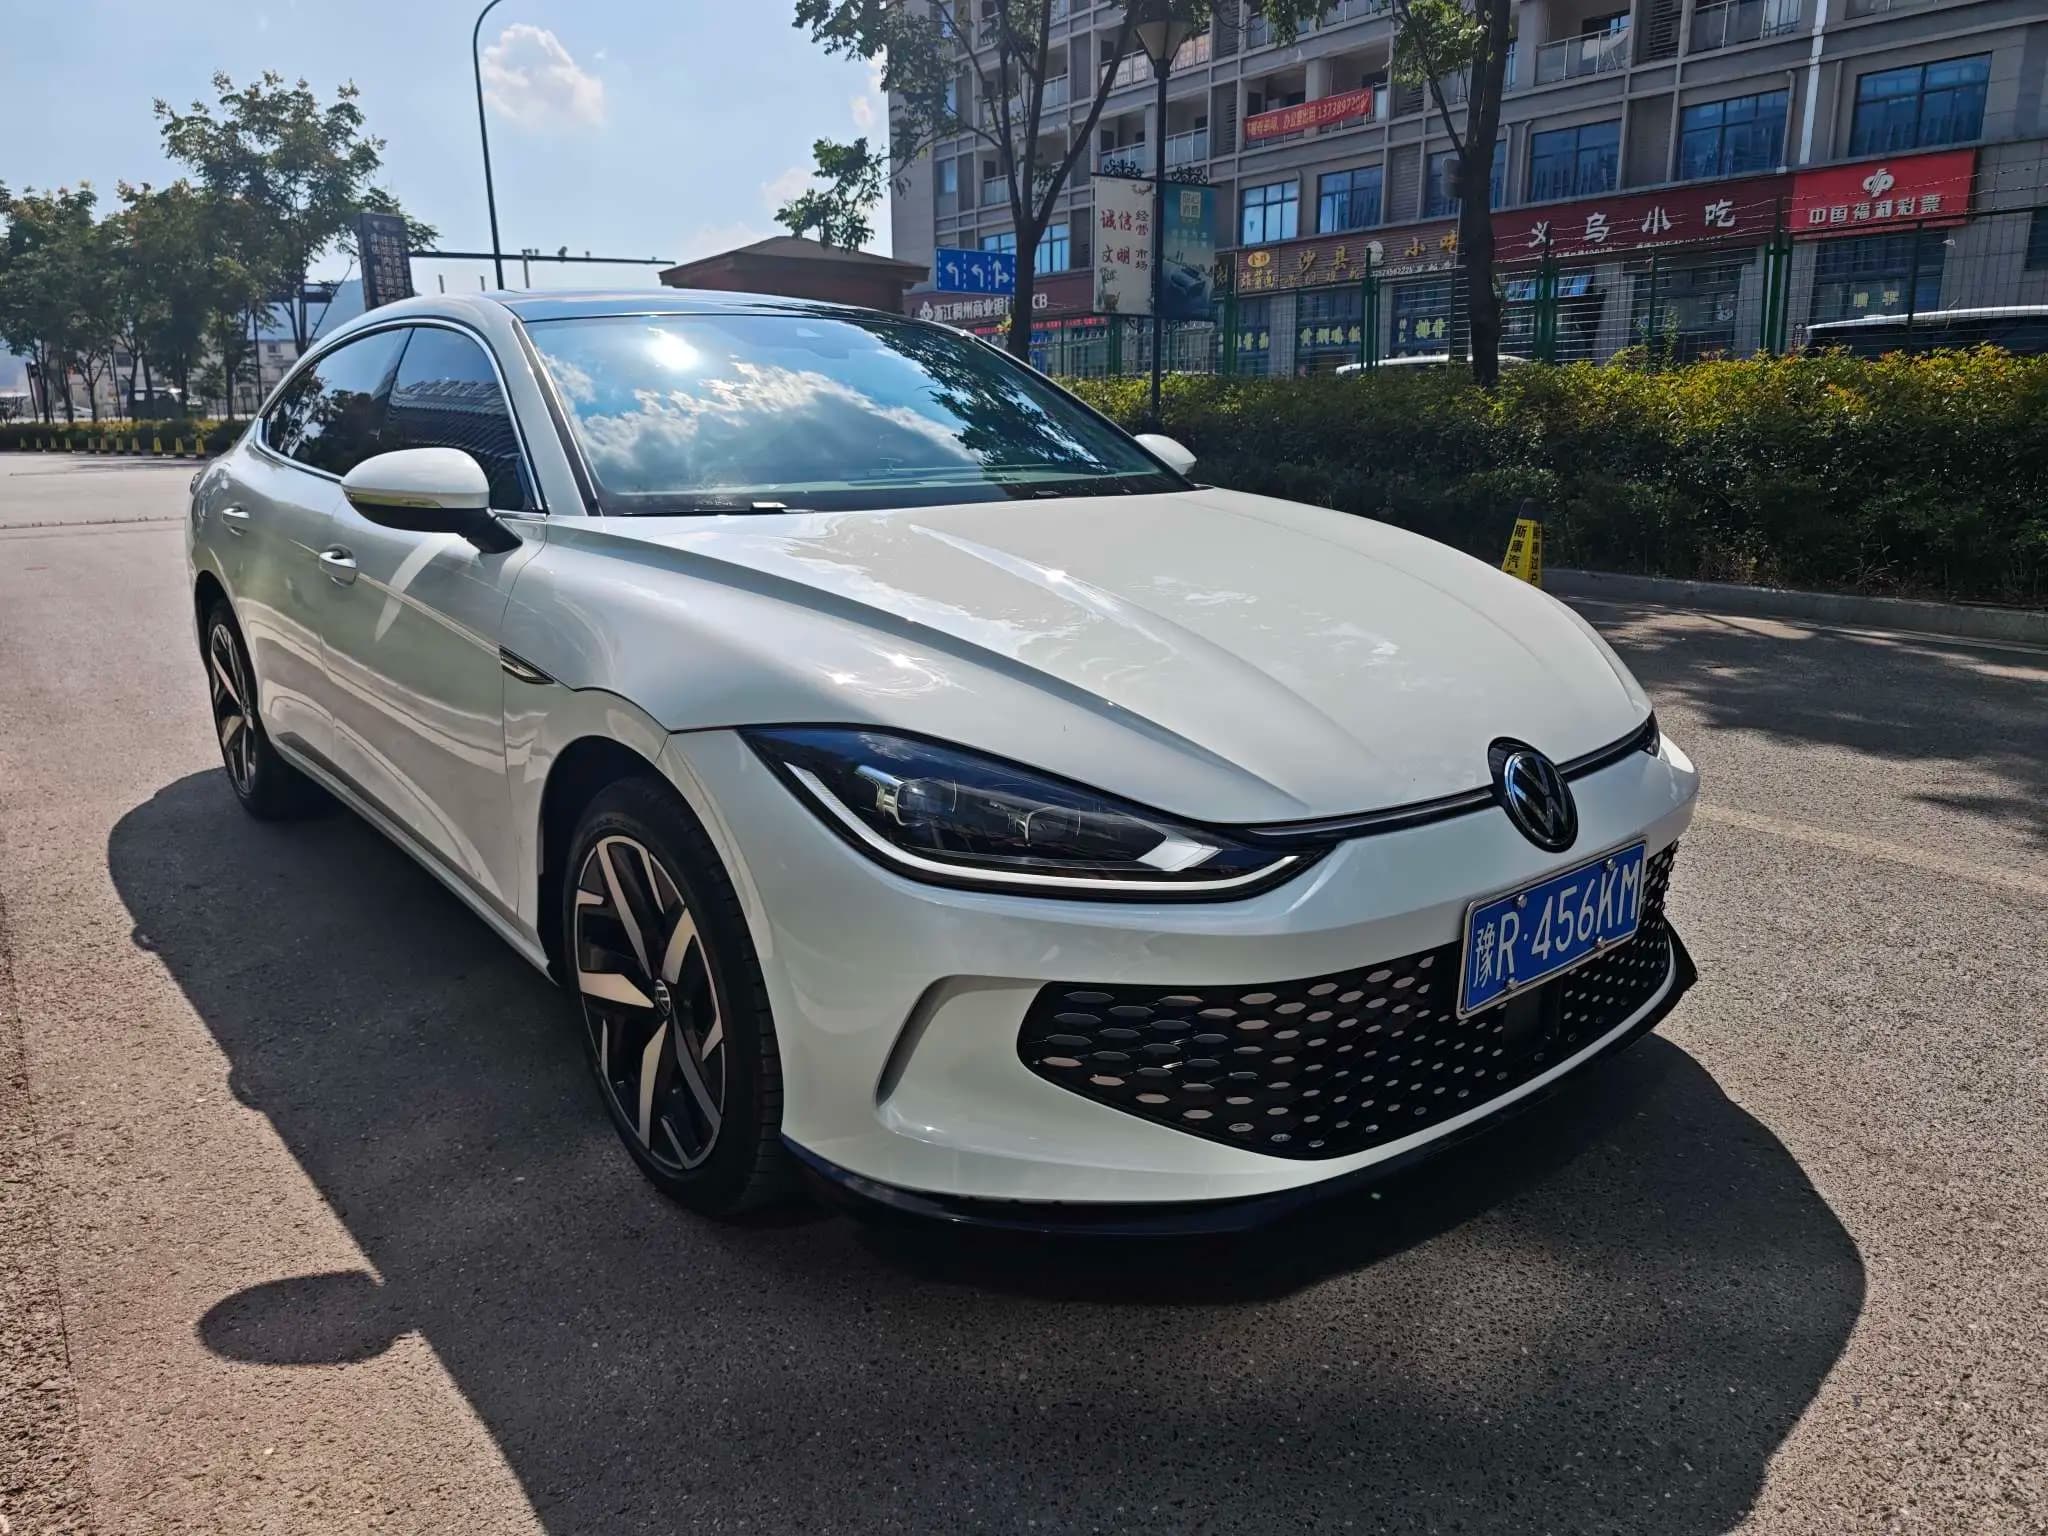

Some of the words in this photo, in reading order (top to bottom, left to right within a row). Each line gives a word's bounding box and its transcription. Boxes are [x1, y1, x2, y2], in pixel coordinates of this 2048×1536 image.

[1101, 209, 1132, 231] 诚信
[1136, 210, 1149, 236] 经营
[1528, 199, 1737, 248] 义乌小吃
[1809, 194, 1942, 225] 中国福利彩票
[1103, 244, 1131, 265] 文明
[1136, 249, 1149, 272] 市场
[1032, 293, 1048, 309] CB
[1472, 858, 1642, 989] 豫R·456KM
